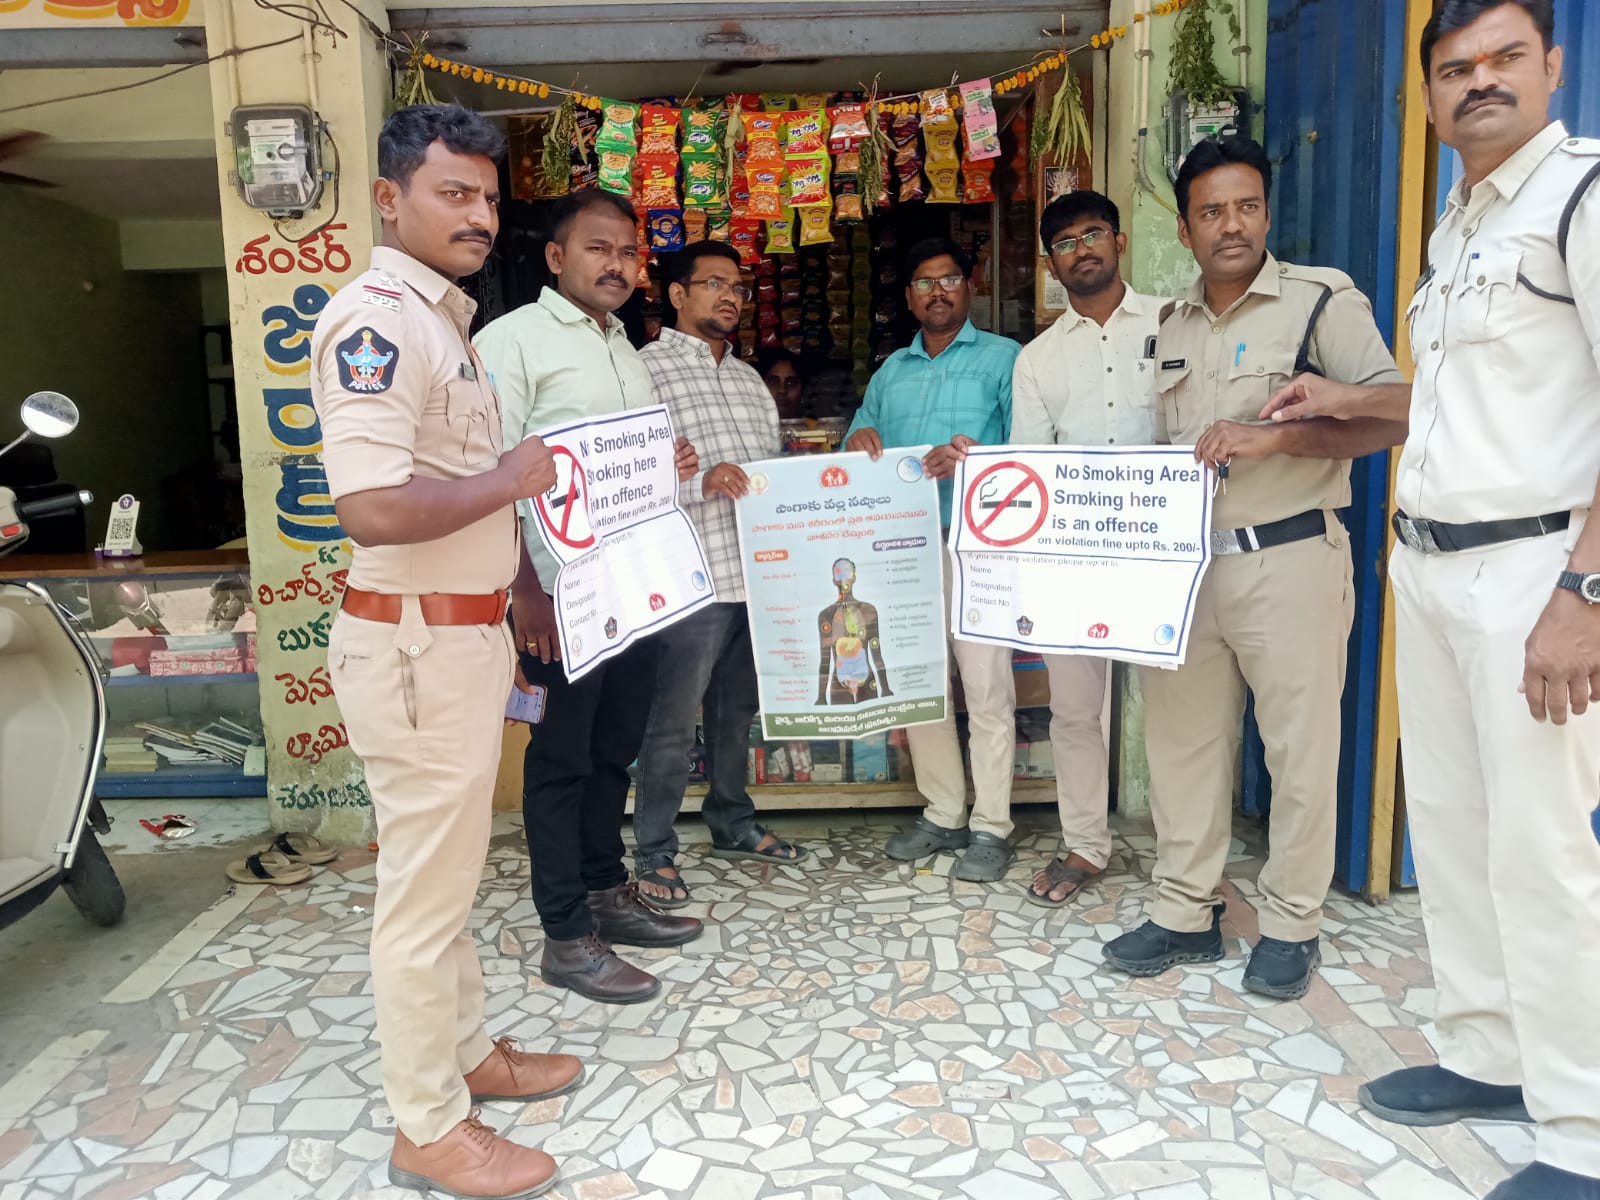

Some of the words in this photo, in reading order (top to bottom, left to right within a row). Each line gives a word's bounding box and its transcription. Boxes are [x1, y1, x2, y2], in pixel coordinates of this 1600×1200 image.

[236, 223, 351, 274] శంకర్
[348, 380, 386, 391] POLICE
[579, 440, 589, 458] N
[594, 430, 646, 454] Smoking
[648, 426, 670, 443] Area
[634, 457, 657, 473] here
[1055, 464, 1080, 480] No
[1082, 464, 1154, 485] Smoking
[1159, 465, 1200, 482] Area
[612, 483, 654, 506] offence
[1054, 489, 1124, 511] Smoking
[1130, 491, 1167, 508] here
[618, 510, 631, 521] fine
[1052, 514, 1066, 530] is
[1072, 517, 1090, 531] an
[1095, 516, 1159, 534] offence
[1037, 536, 1052, 545] on
[1055, 536, 1100, 548] violation
[1102, 537, 1122, 549] fine
[1125, 540, 1150, 552] upto
[1153, 540, 1170, 552] Rs.
[1173, 542, 1200, 553] 200/-
[974, 553, 989, 561] you
[1006, 554, 1019, 564] any
[1022, 555, 1056, 565] violation
[1057, 557, 1084, 567] please
[970, 565, 992, 574] Name
[970, 580, 1012, 593] Designation
[970, 595, 997, 606] Contact
[998, 596, 1010, 607] No
[569, 612, 591, 629] Contact
